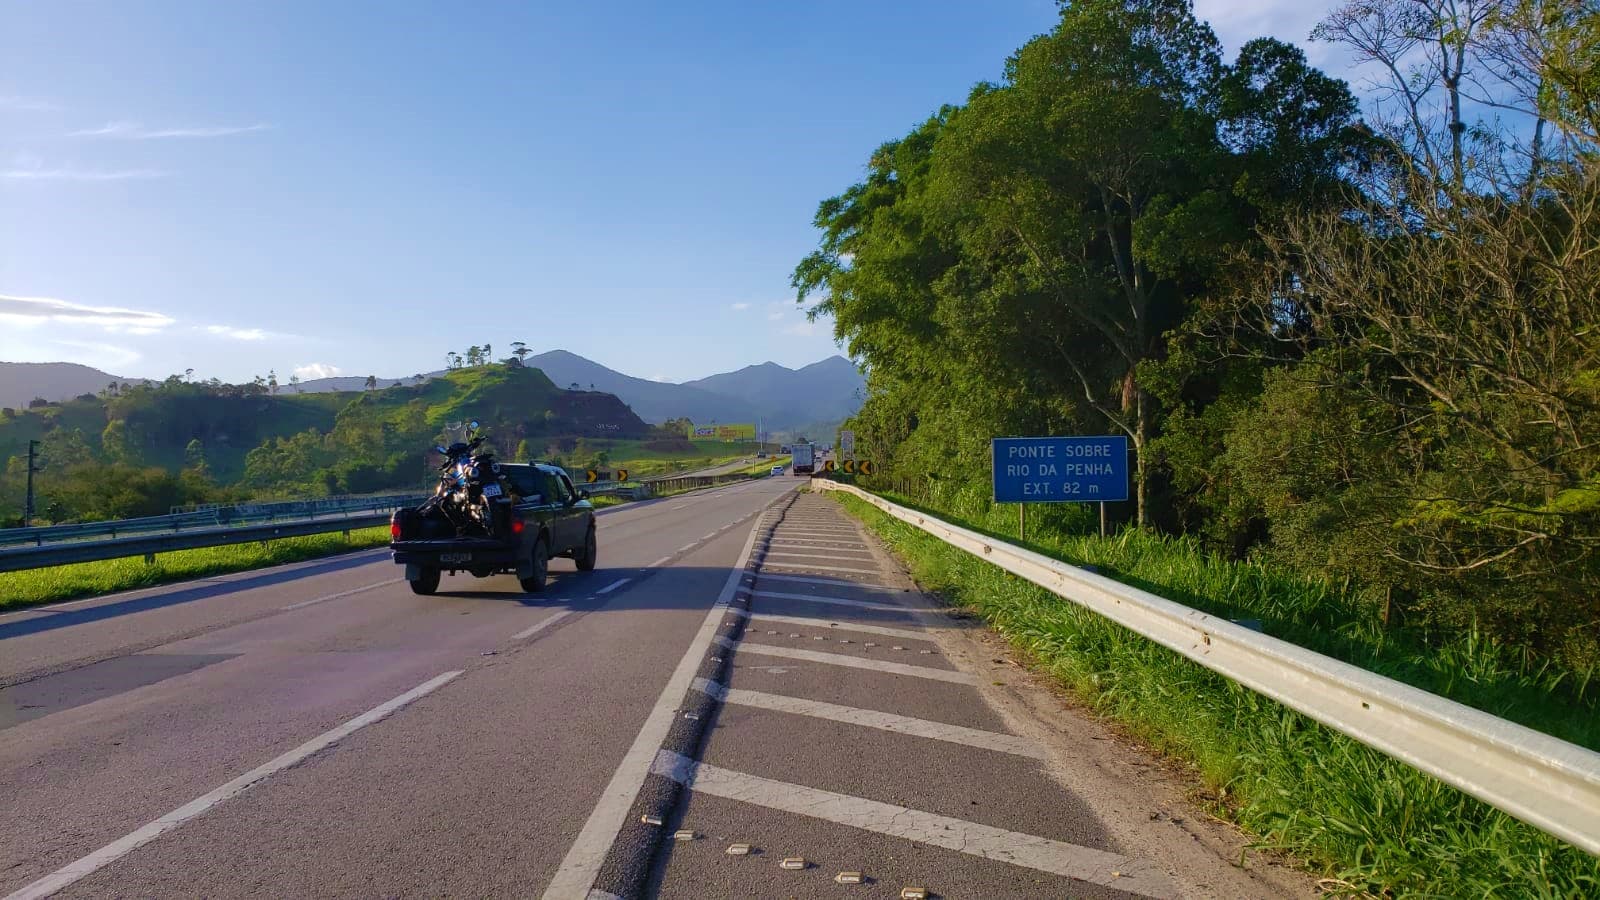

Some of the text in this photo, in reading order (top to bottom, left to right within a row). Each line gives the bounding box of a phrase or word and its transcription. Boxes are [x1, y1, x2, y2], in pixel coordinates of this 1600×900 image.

[1009, 445, 1111, 458] PONTE SOBRE
[1007, 463, 1113, 477] RIO DA PENHA
[1023, 482, 1099, 495] EXT. 82 m
